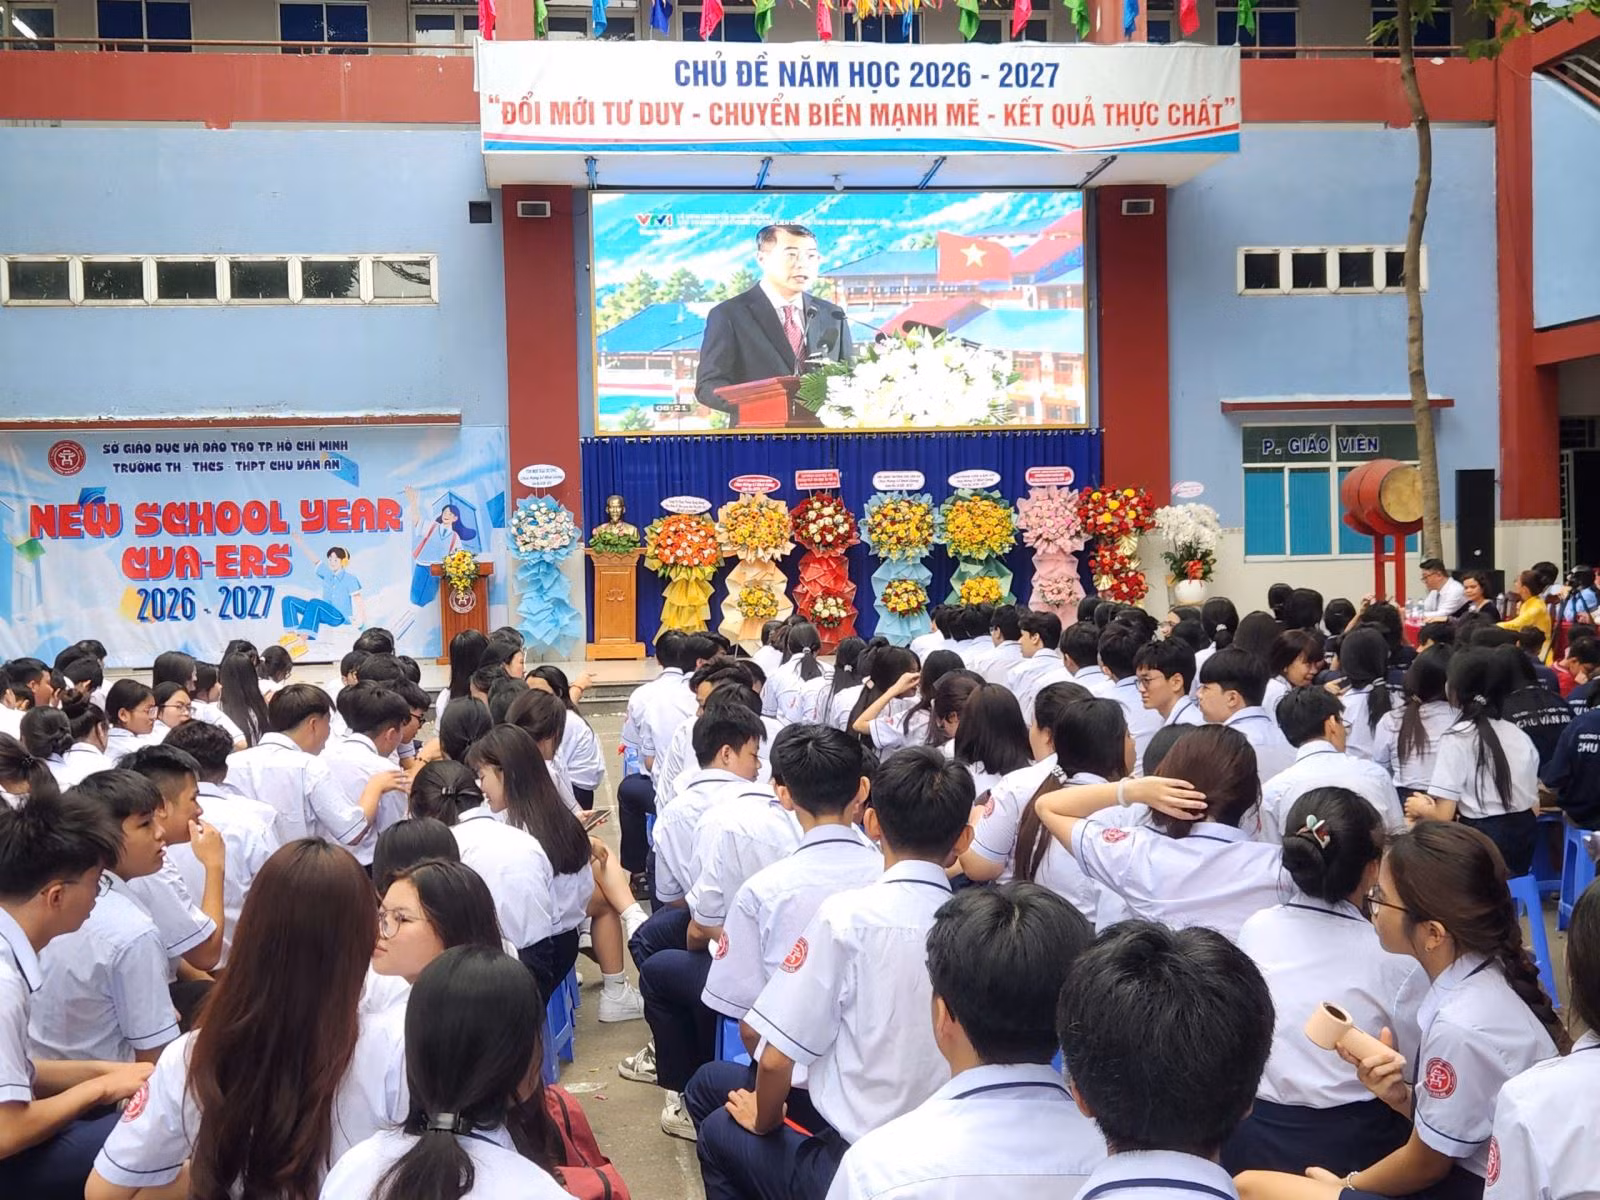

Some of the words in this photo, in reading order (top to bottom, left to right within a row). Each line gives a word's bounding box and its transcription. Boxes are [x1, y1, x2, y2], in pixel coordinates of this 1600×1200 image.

[675, 51, 727, 87] CHỦ
[736, 52, 769, 87] ĐỀ
[779, 55, 840, 88] NĂM
[849, 61, 900, 94] HỌC
[909, 61, 971, 88] 2026
[999, 62, 1060, 88] 2027
[550, 96, 595, 125] MỚI
[602, 99, 633, 125] TƯ
[639, 102, 684, 126] DUY
[709, 92, 800, 127] CHUYỂN
[808, 95, 861, 127] BIẾN
[870, 103, 937, 131] MẠNH
[946, 98, 980, 127] MẼ
[1003, 96, 1043, 126] KẾT
[1052, 96, 1095, 127] QUẢ
[1103, 101, 1160, 131] THỰC
[1168, 95, 1235, 126] CHẤT”
[102, 441, 120, 454] SỞ
[123, 441, 151, 454] GIÁO
[155, 442, 180, 455] DỤC
[183, 440, 199, 453] VÀ
[231, 441, 254, 454] TẠO
[258, 441, 273, 452] TP.
[276, 436, 293, 452] HỒ
[296, 439, 316, 451] CHÍ
[319, 440, 348, 451] MINH
[1262, 438, 1282, 455] P.
[1288, 433, 1330, 454] GIÁO
[1338, 433, 1379, 453] VIÊN
[113, 460, 162, 473] TRƯỜNG
[165, 462, 181, 472] TH
[192, 461, 224, 472] THCS
[235, 460, 265, 471] THPT
[269, 460, 293, 471] CHU
[297, 458, 321, 470] VĂN
[324, 459, 340, 470] AN
[30, 502, 123, 539] NEW
[134, 500, 289, 537] SCHOOL
[300, 498, 403, 532] YEAR
[122, 543, 292, 580] CVA-ERS
[137, 586, 196, 622] 2026
[218, 585, 275, 620] 2027
